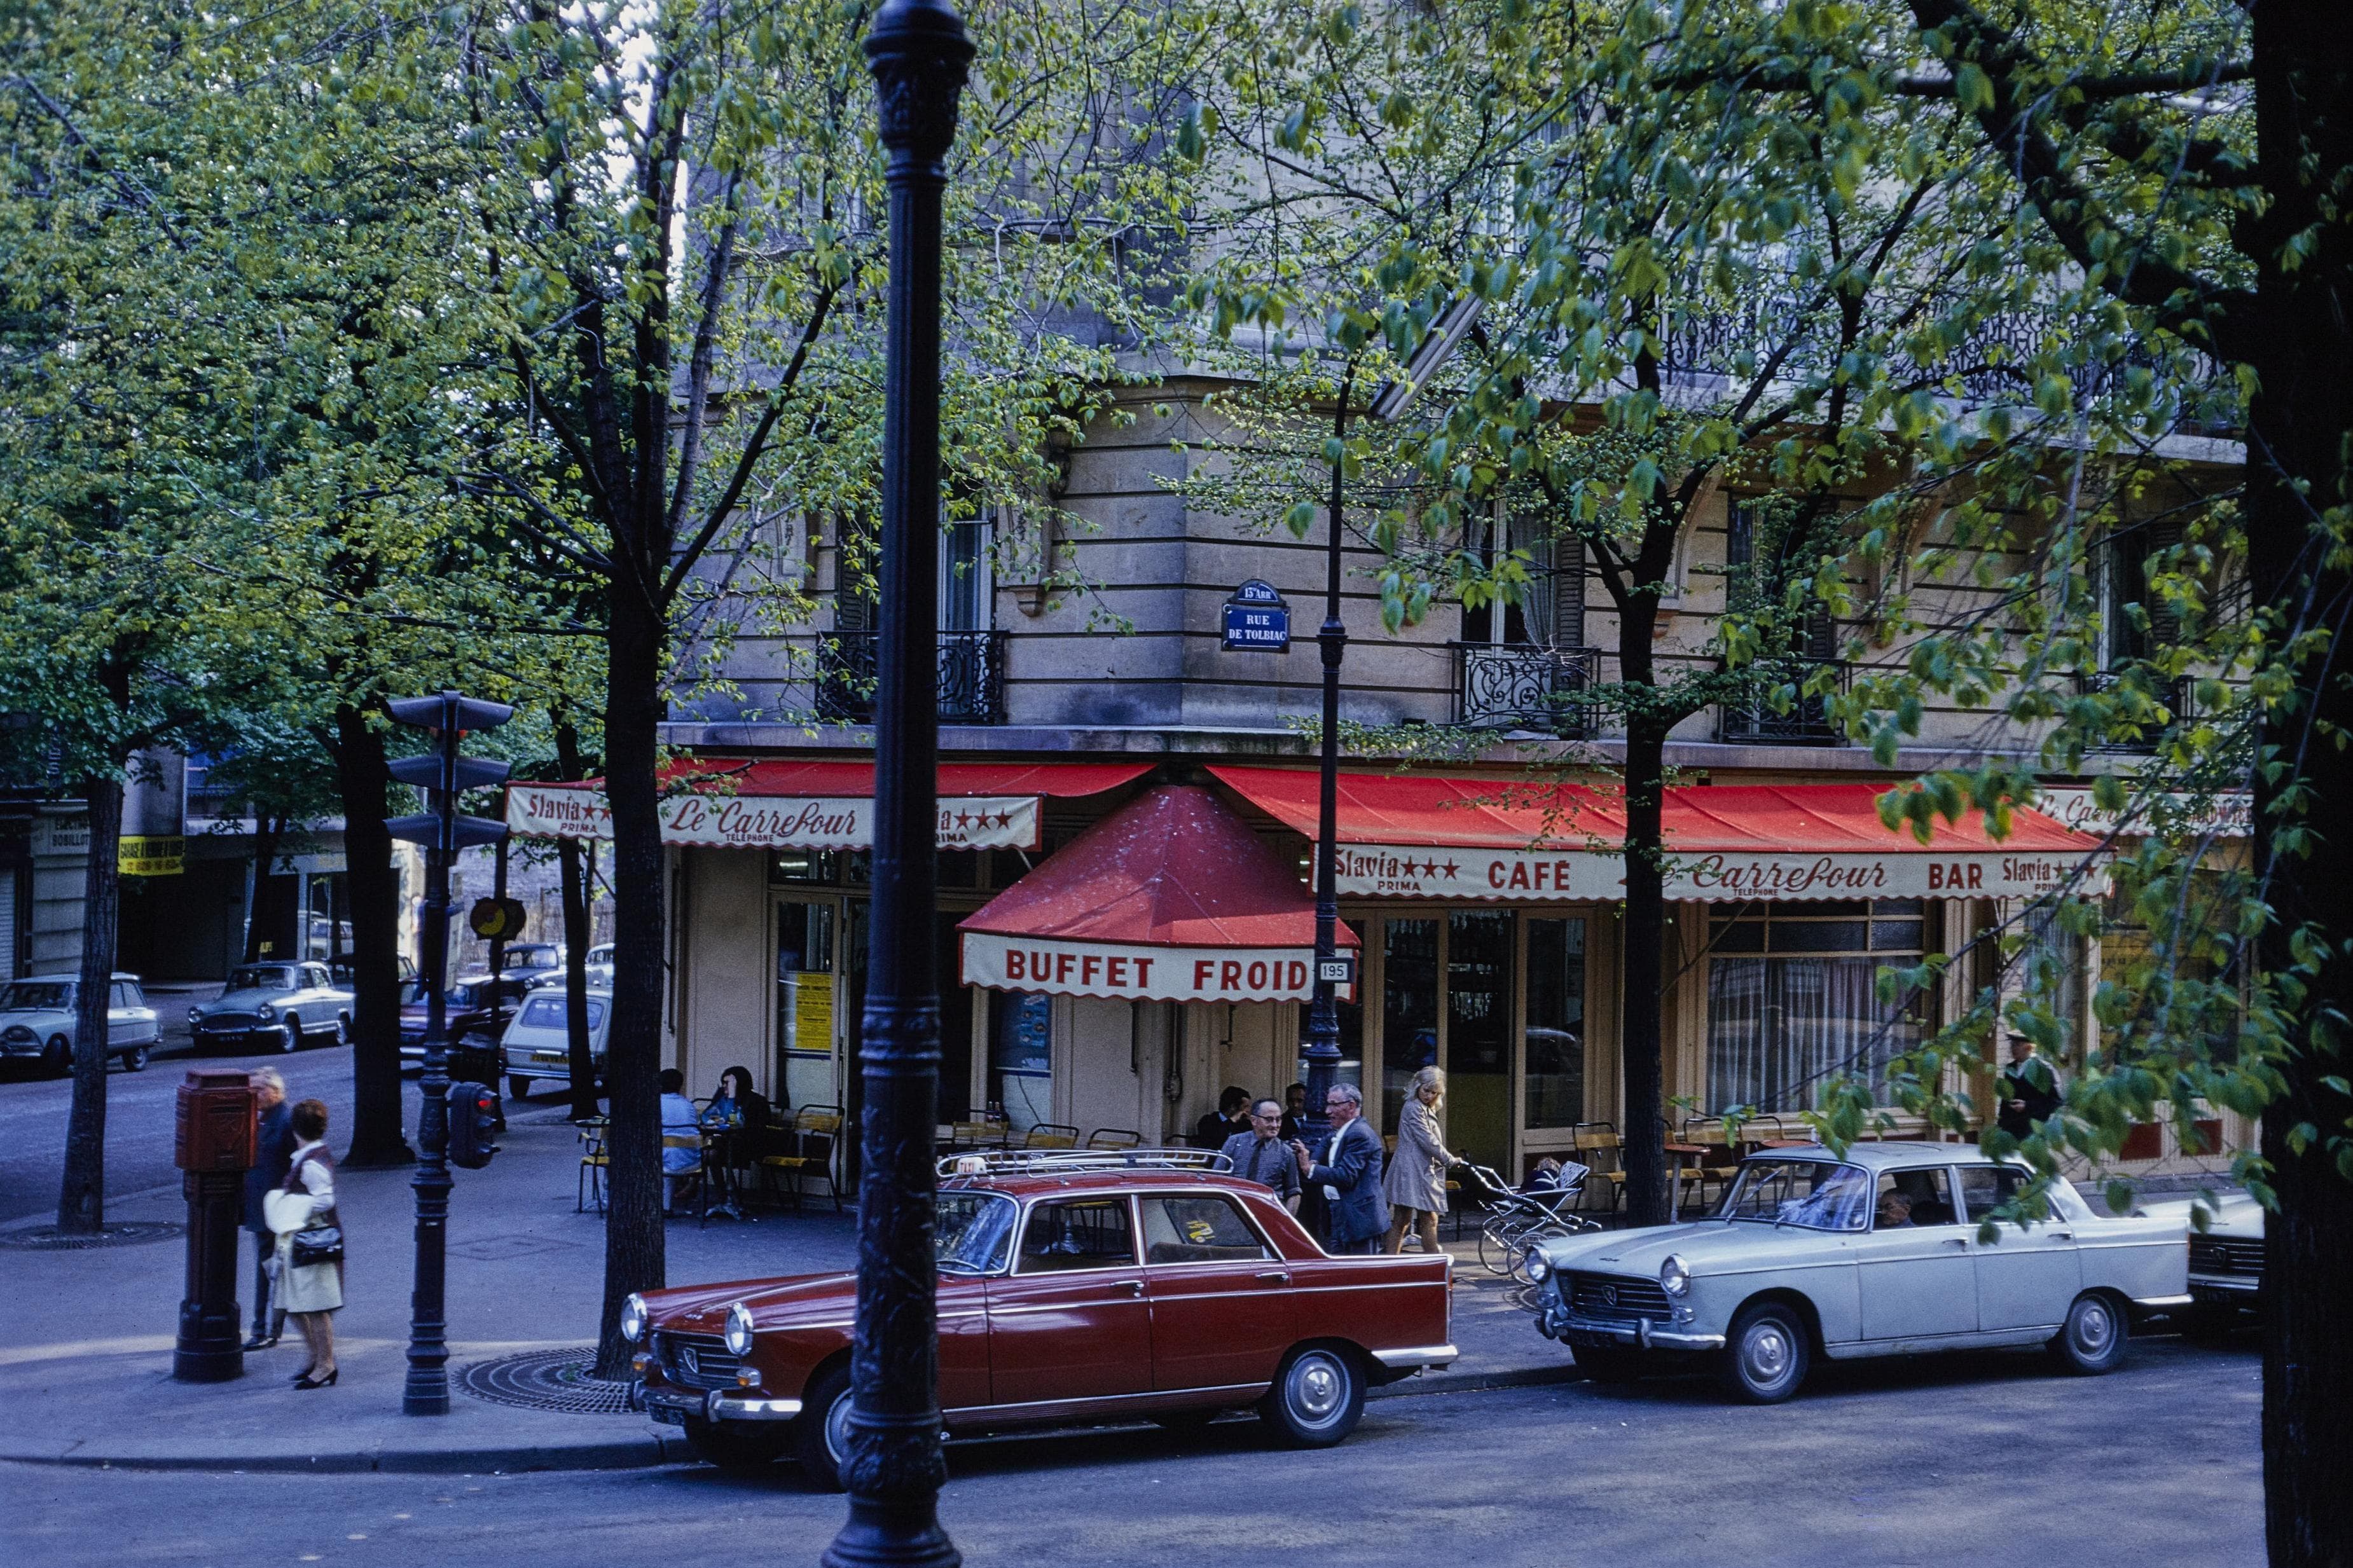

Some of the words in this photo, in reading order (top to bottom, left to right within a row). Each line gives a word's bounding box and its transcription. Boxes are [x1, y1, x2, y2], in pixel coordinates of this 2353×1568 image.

[1246, 615, 1270, 625] RUE
[1229, 629, 1242, 639] DE
[1245, 629, 1286, 640] TOLBIAC
[527, 794, 580, 820] Slavia
[668, 799, 705, 831] Le
[718, 801, 856, 837] Carrefour
[560, 822, 597, 832] PRIMA
[935, 832, 967, 842] RIMA
[1335, 849, 1398, 877] Slavia
[1693, 855, 1887, 893] Carrefour
[2003, 858, 2050, 881] Slavia
[1377, 881, 1421, 891] PRIMA
[1929, 863, 1982, 890] BAR
[1005, 949, 1154, 988] BUFFET
[1194, 960, 1308, 991] FROID
[1323, 965, 1344, 977] 195
